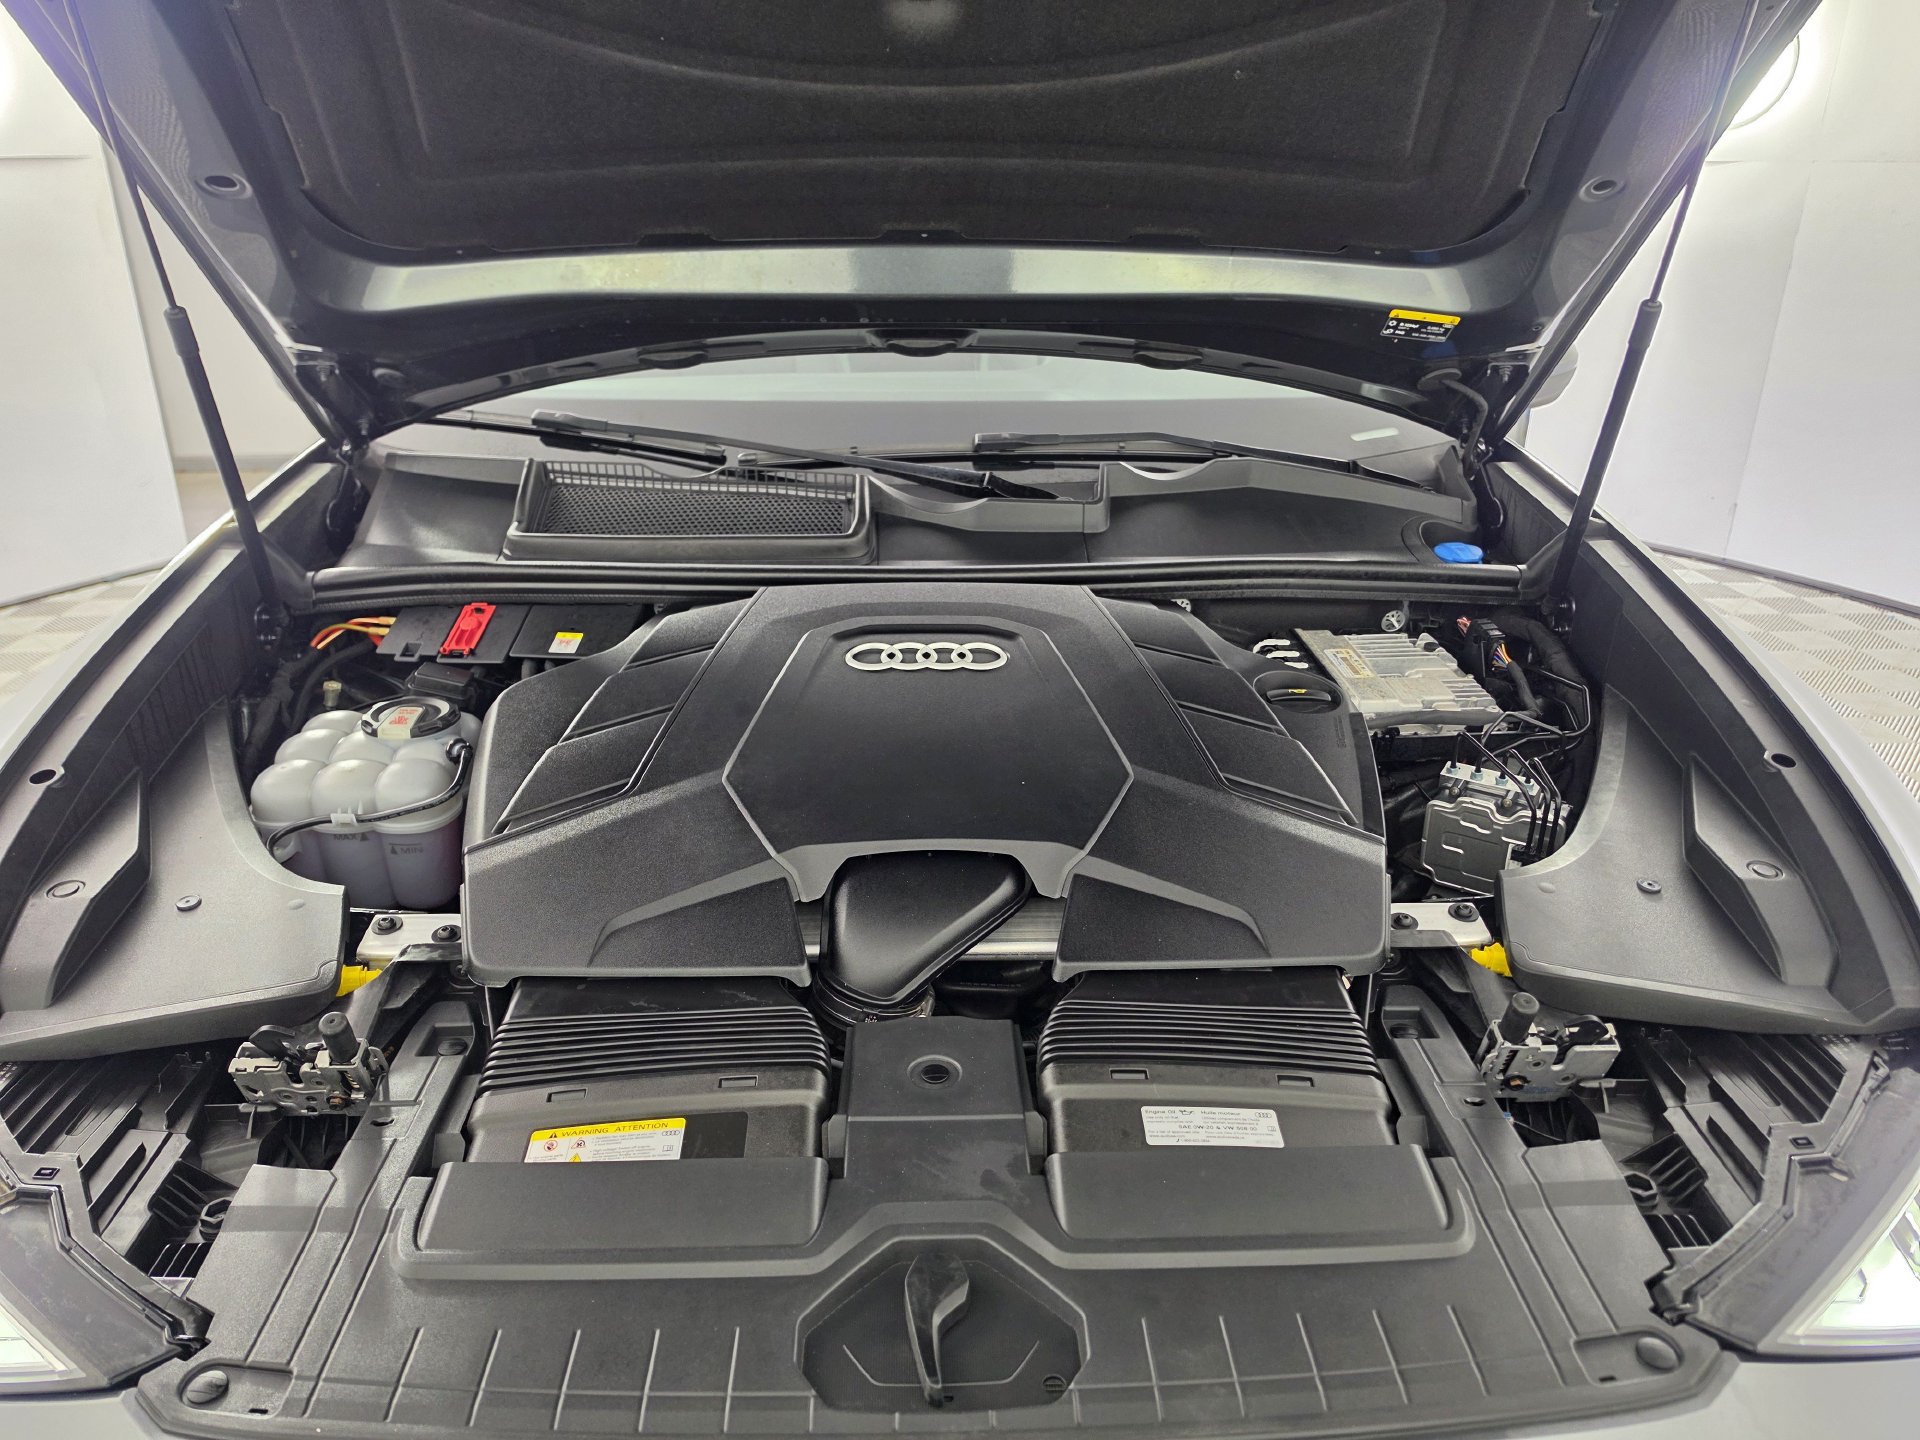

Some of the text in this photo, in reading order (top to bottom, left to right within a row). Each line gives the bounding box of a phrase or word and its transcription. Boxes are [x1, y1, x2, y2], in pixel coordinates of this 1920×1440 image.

[333, 833, 359, 841] MAX
[400, 847, 425, 855] MIN
[562, 1127, 609, 1137] WARNING
[614, 1122, 669, 1133] ATTENTION
